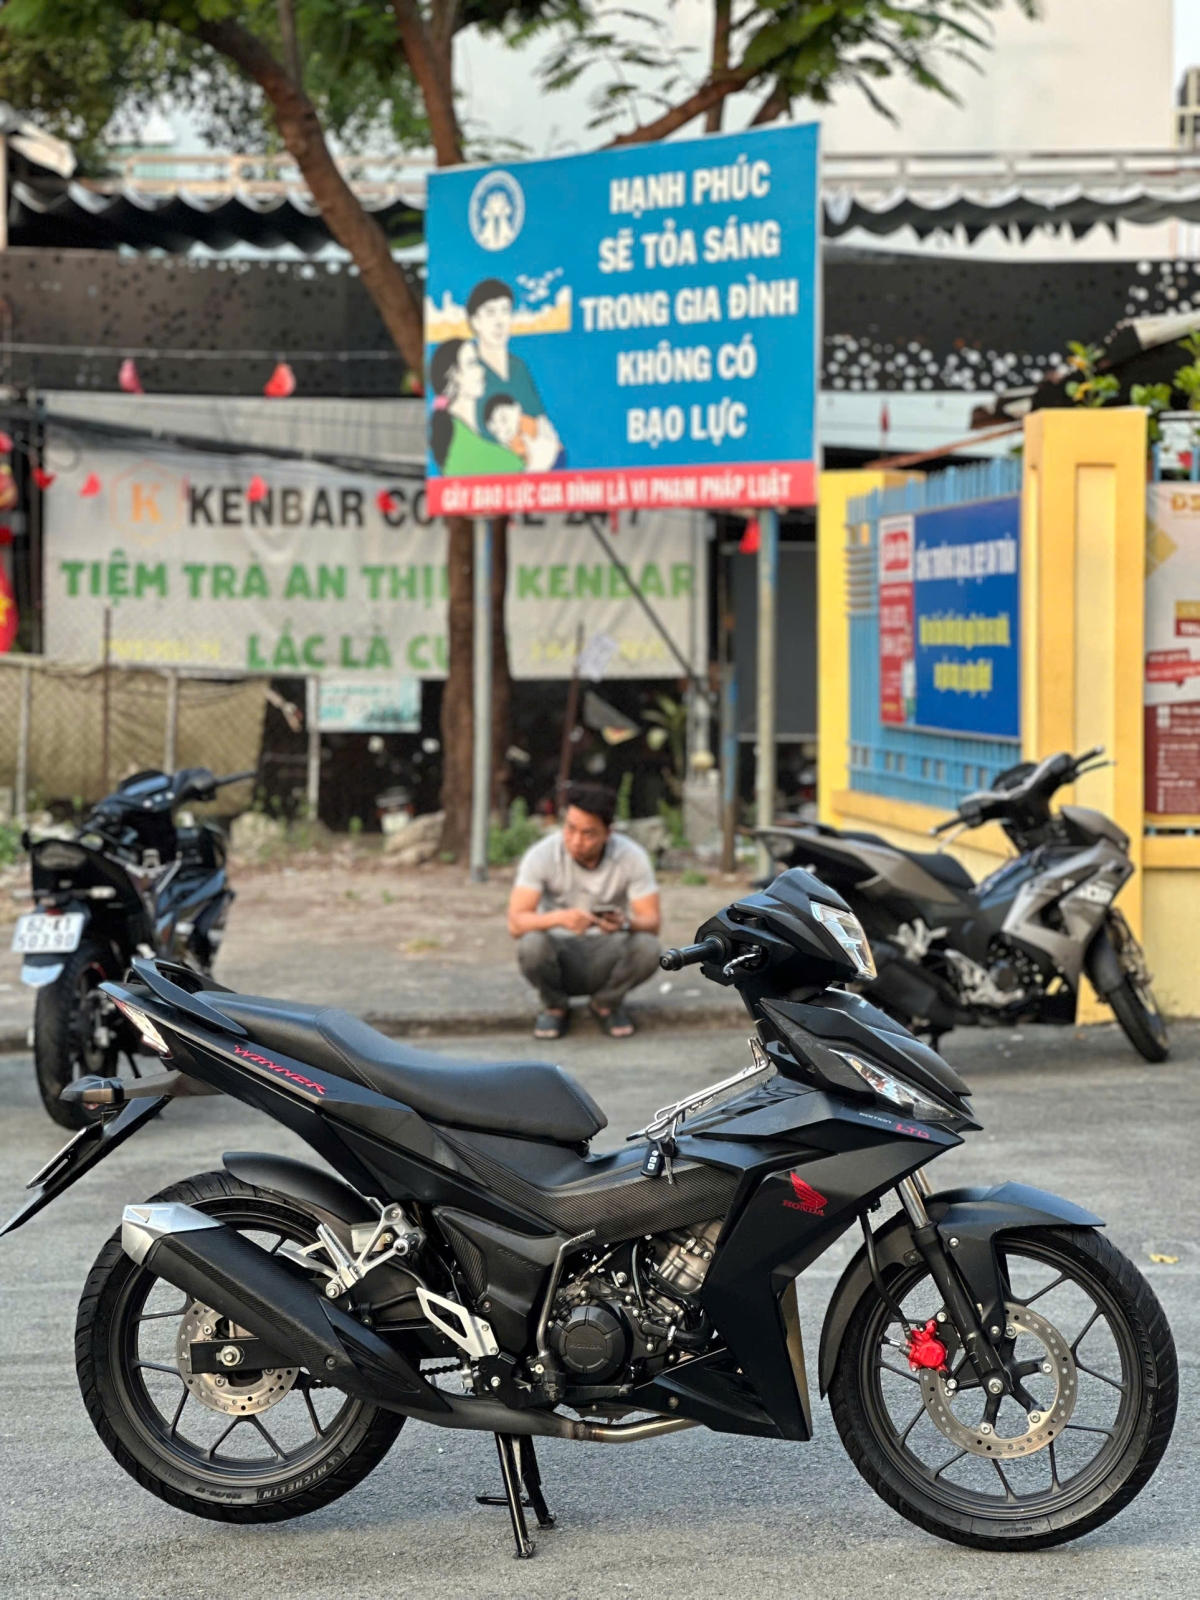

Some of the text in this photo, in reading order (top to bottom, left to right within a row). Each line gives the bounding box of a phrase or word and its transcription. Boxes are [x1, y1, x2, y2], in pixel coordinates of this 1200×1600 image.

[609, 154, 771, 218] HẠNH PHÚC
[598, 215, 781, 274] SẼ TỎA SÁNG
[579, 273, 799, 331] TRONG GIA ĐÌNH
[616, 333, 758, 386] KHÔNG CÓ
[626, 397, 748, 449] BẠO LỰC
[130, 482, 162, 523] K
[188, 485, 365, 528] KENBAR
[60, 549, 168, 605] TIỆM
[284, 562, 348, 599] AN
[516, 562, 693, 599] KENBAR
[234, 1043, 327, 1095] WINNER
[895, 1122, 930, 1139] LTD
[782, 1199, 825, 1217] HONDA
[262, 1464, 328, 1499] MICHELIN
